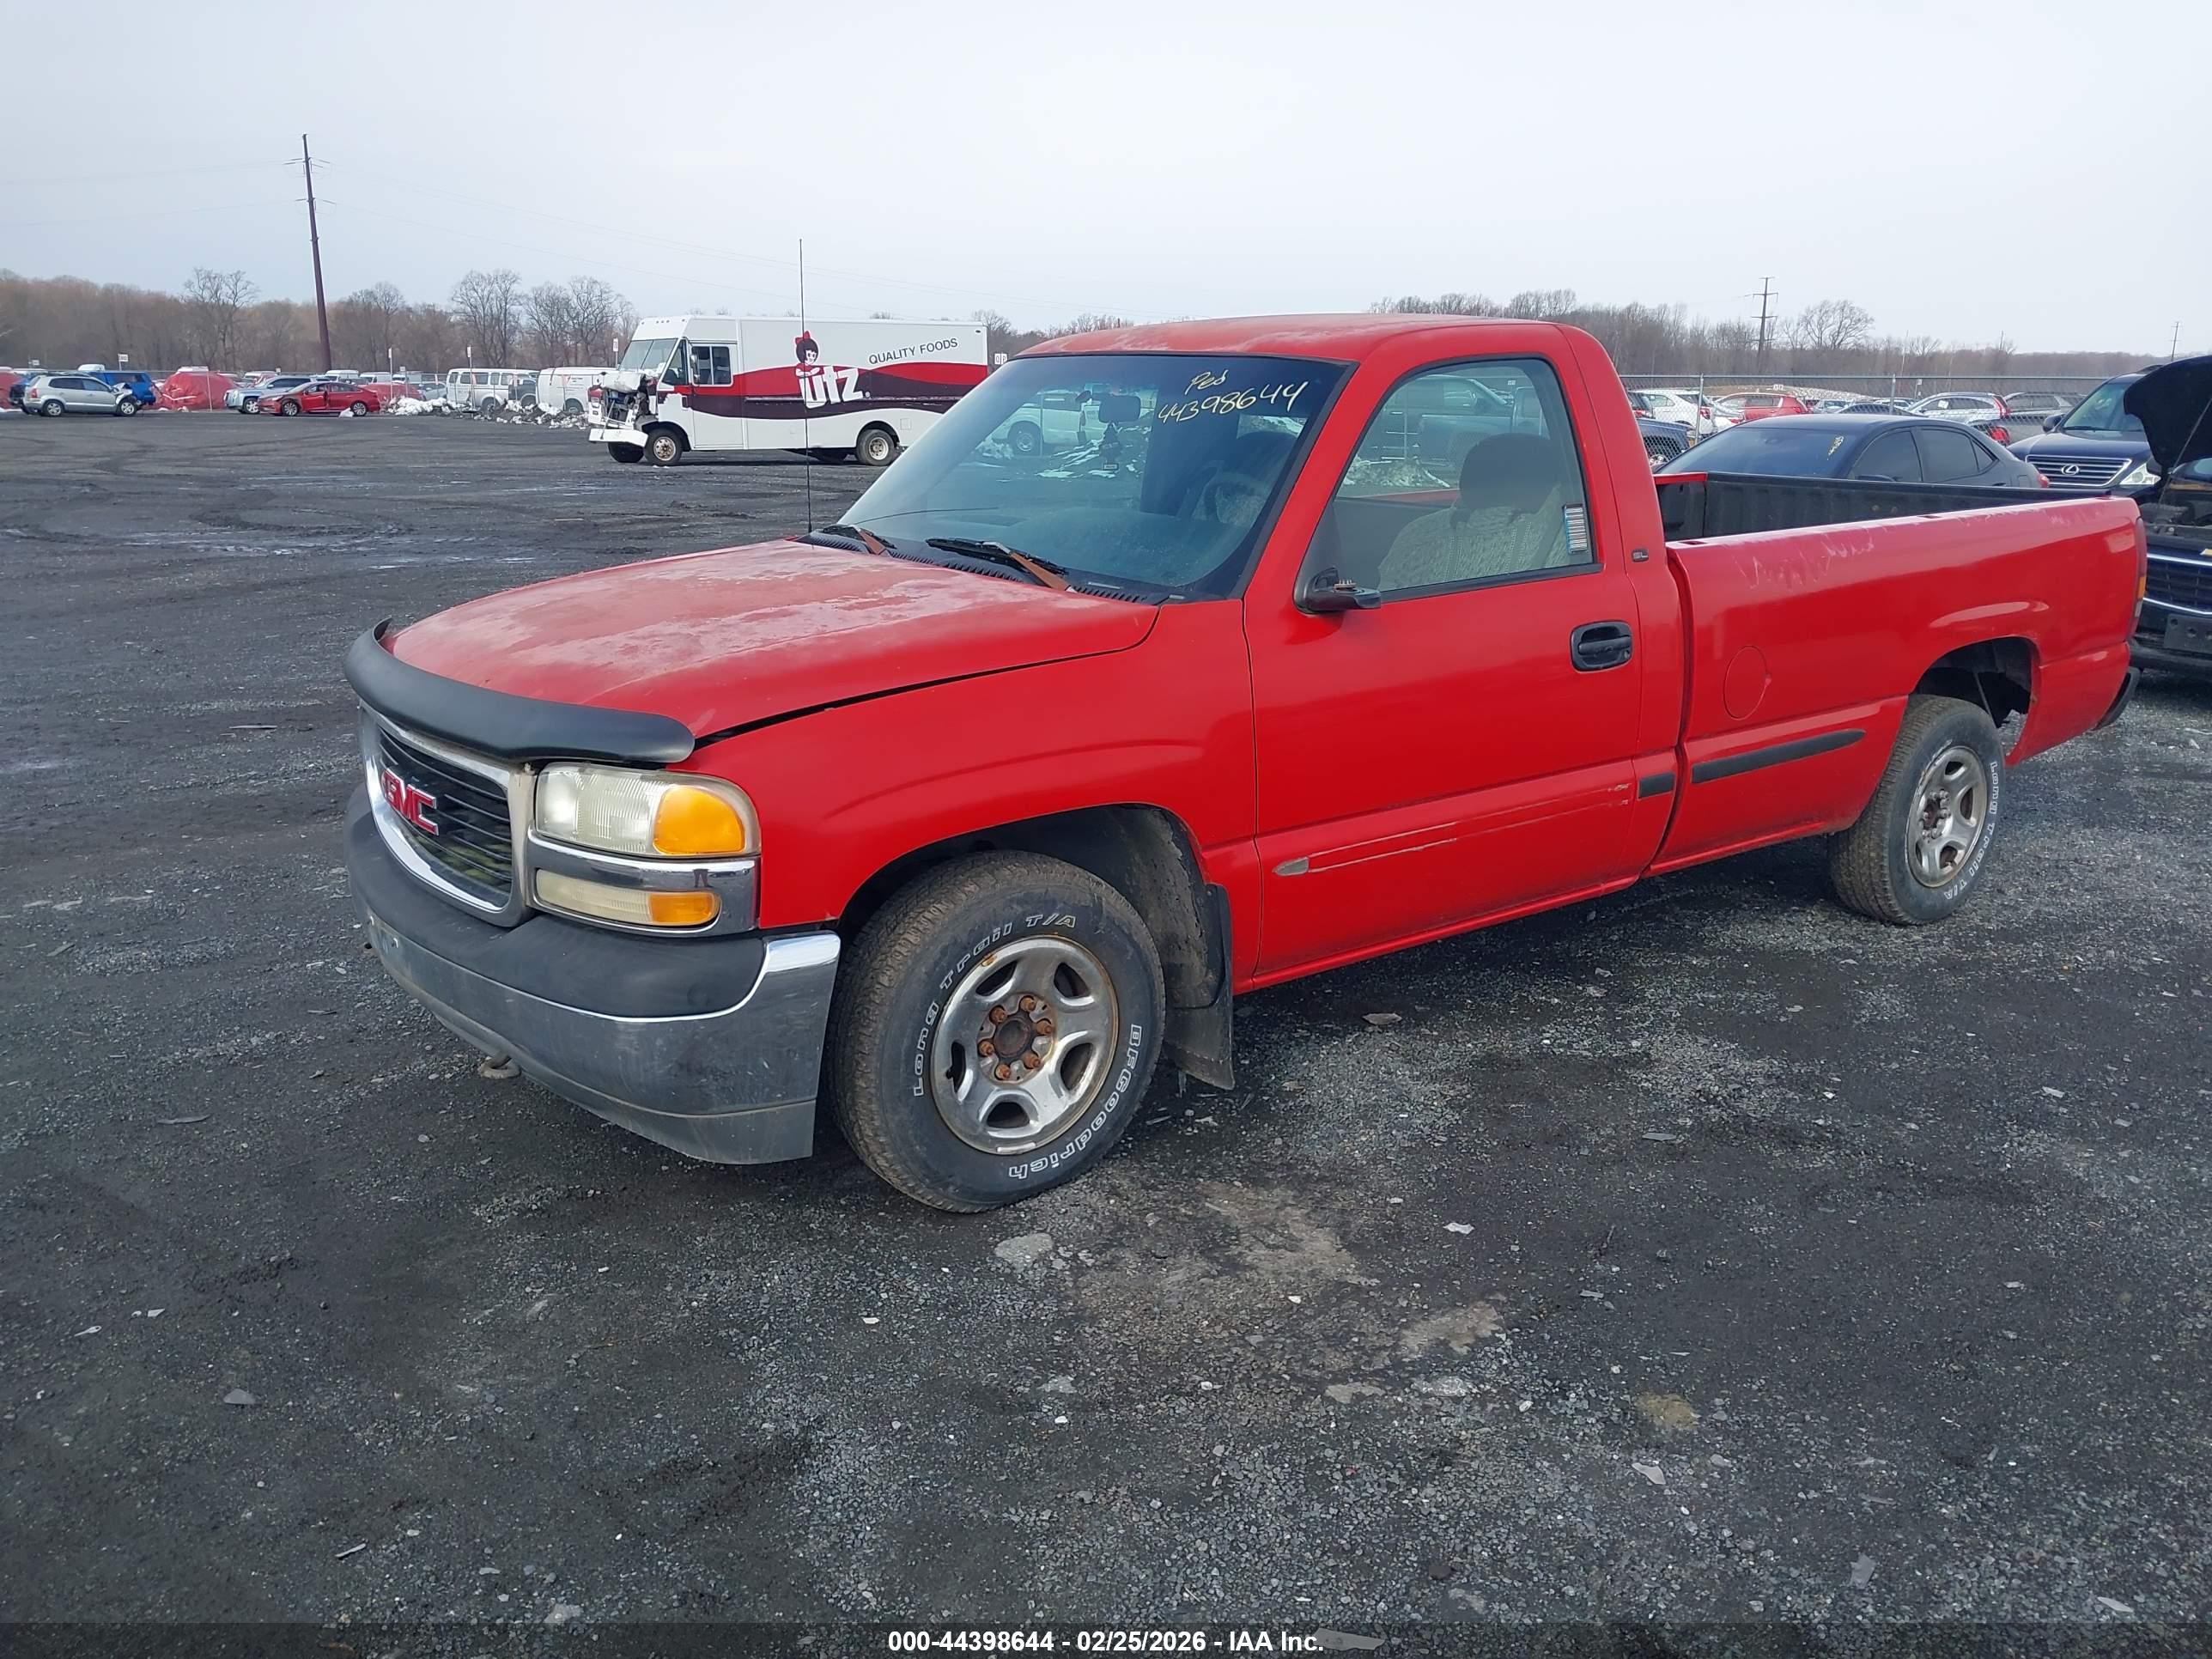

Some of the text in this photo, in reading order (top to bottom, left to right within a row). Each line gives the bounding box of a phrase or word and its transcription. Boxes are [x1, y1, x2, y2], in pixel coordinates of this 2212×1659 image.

[868, 337, 958, 365] QUALITY FOODS
[1158, 380, 1309, 424] 44398644
[913, 914, 1077, 1097] Long Trail T/A
[1007, 1023, 1144, 1180] BFGoodrich
